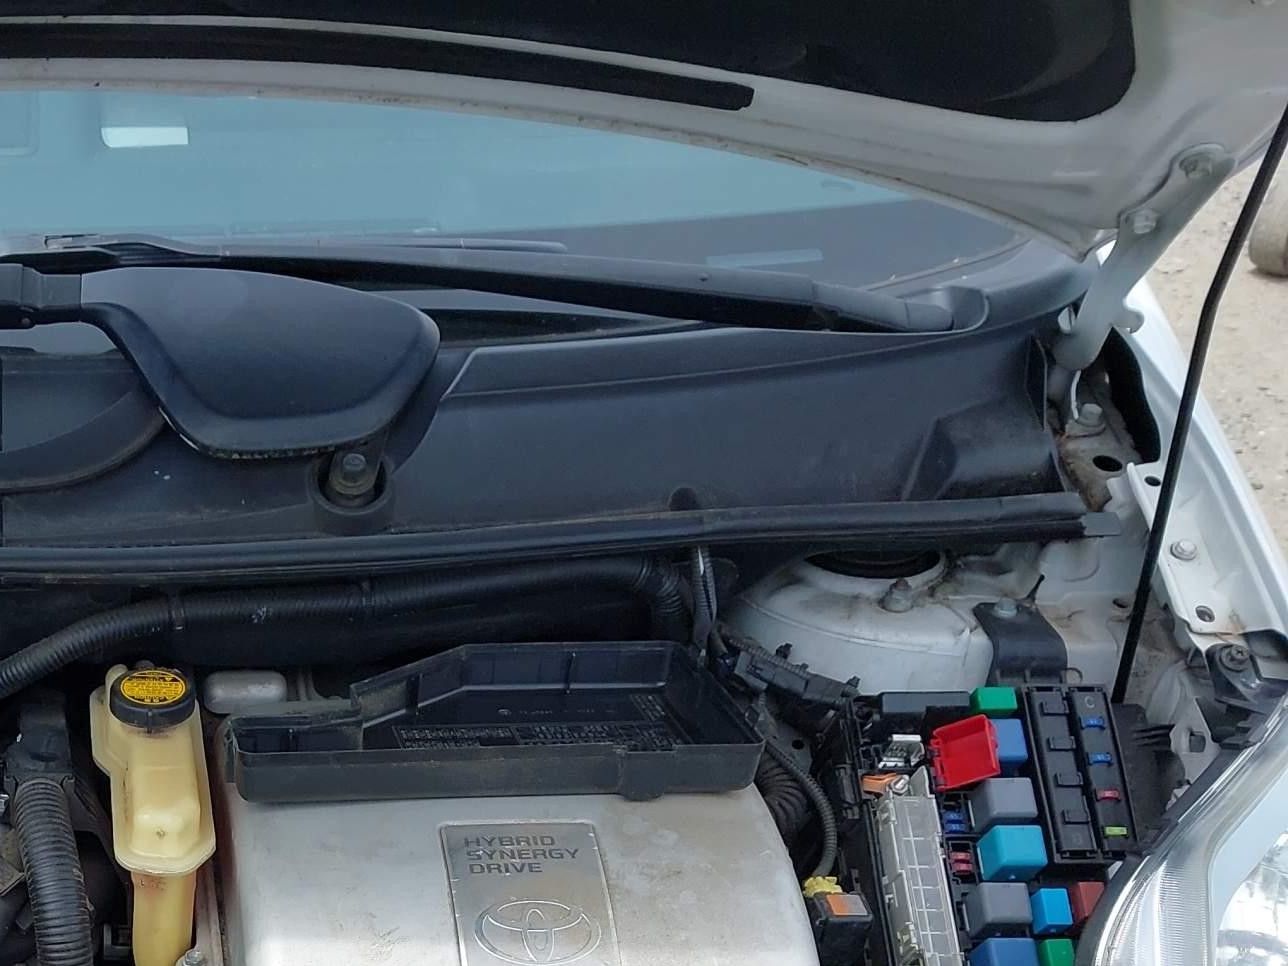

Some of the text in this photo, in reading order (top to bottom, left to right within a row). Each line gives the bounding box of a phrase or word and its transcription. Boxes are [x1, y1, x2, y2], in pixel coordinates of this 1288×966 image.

[464, 836, 555, 847] HYBRID
[466, 848, 579, 860] SYNERGY
[469, 862, 543, 874] DRIVE
